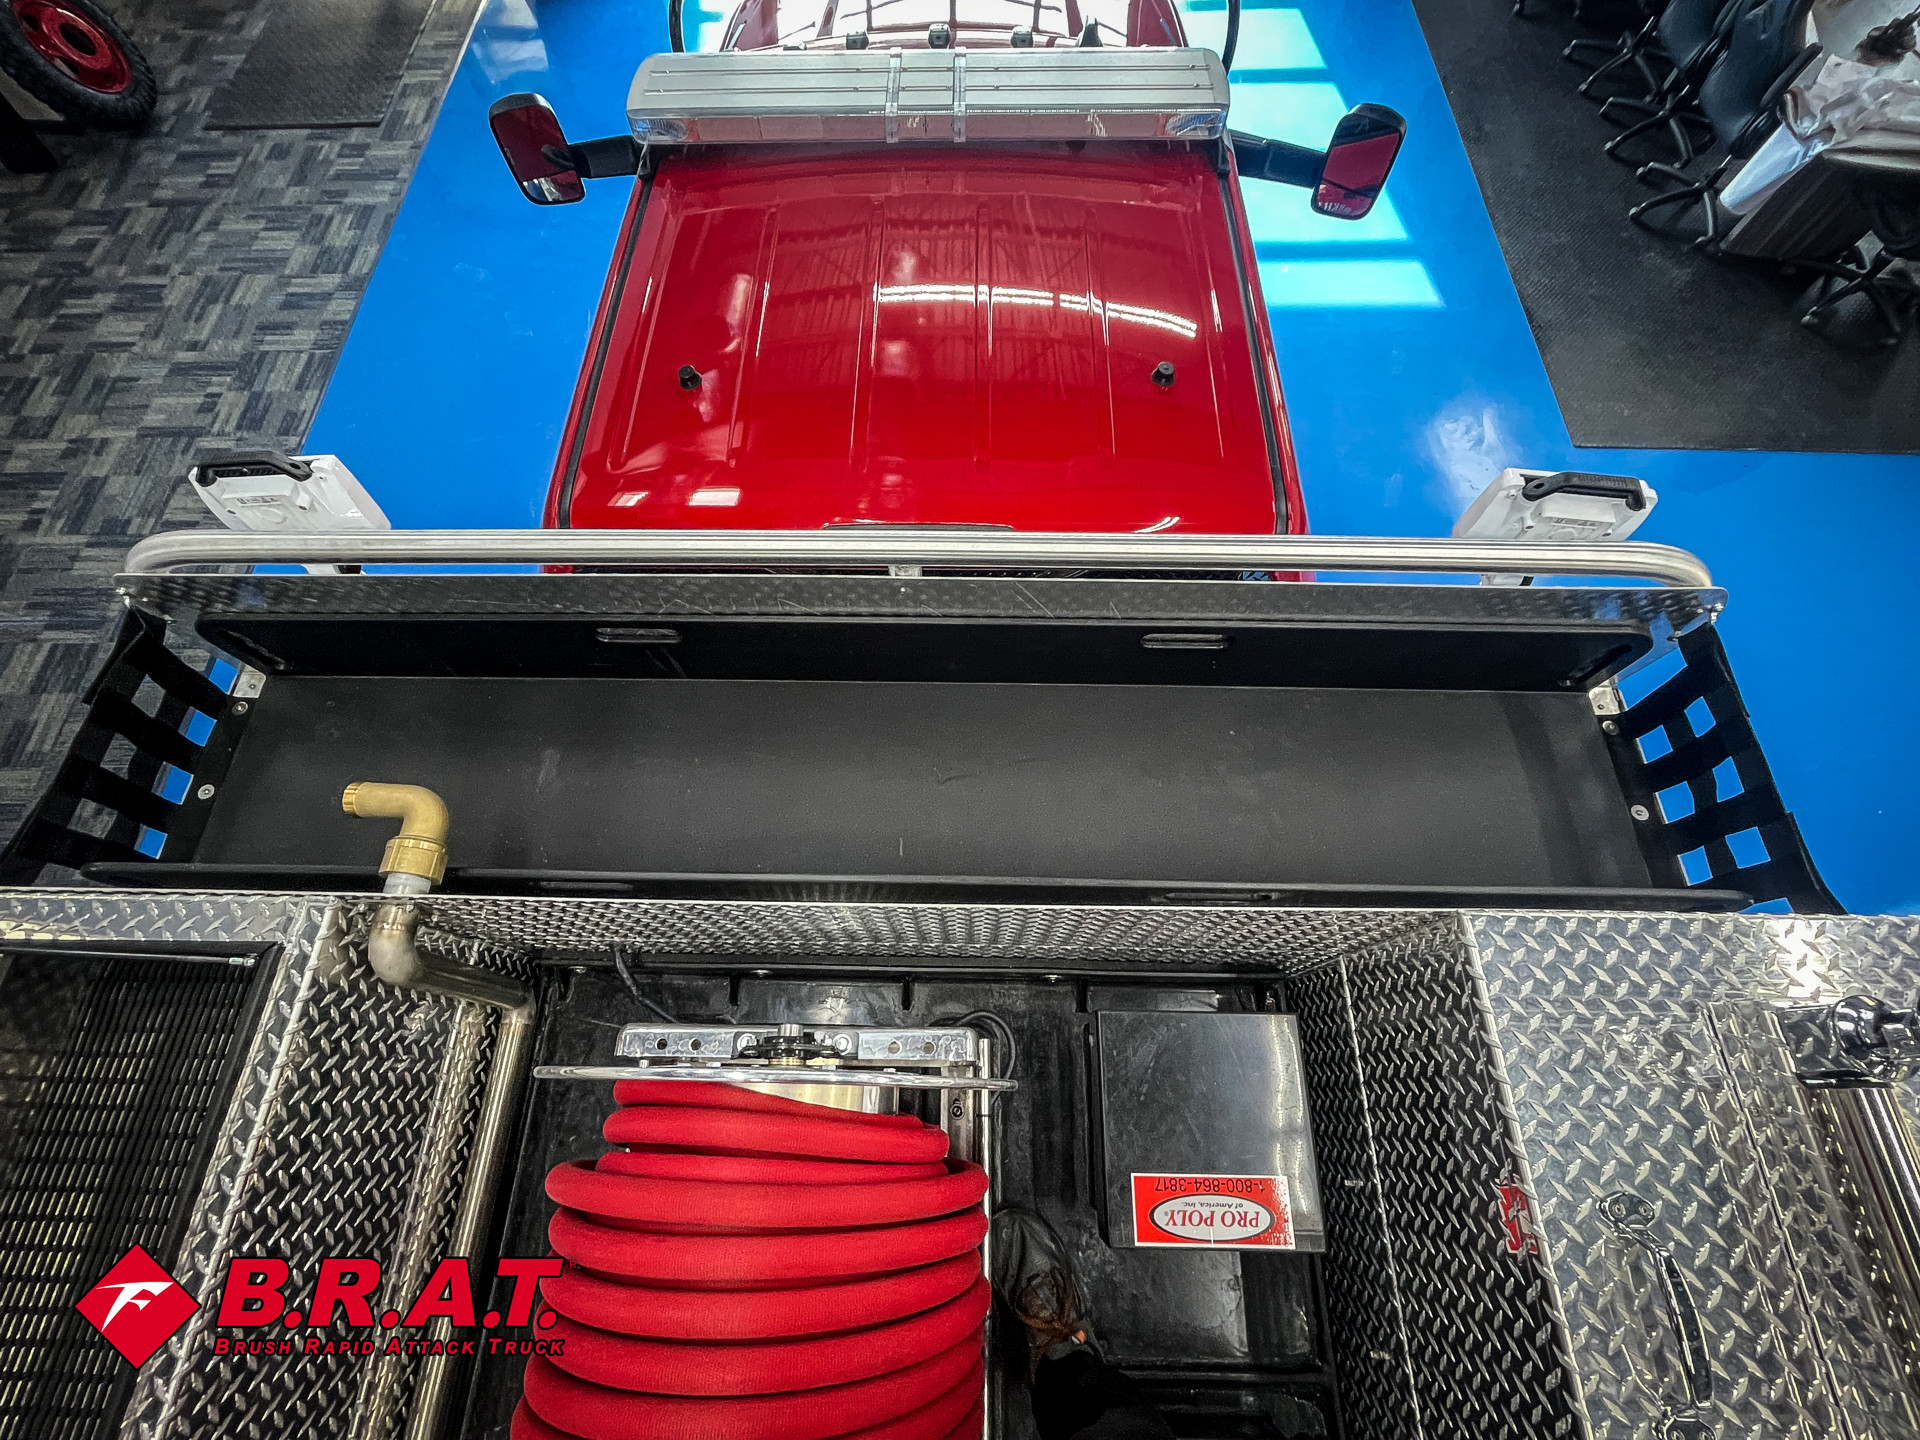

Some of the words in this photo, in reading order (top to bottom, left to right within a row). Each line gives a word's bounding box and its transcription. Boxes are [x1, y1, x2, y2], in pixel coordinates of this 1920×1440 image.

[1154, 1177, 1266, 1192] 1-800-864-3817
[1166, 1209, 1215, 1227] POLY
[1220, 1210, 1260, 1228] PRO
